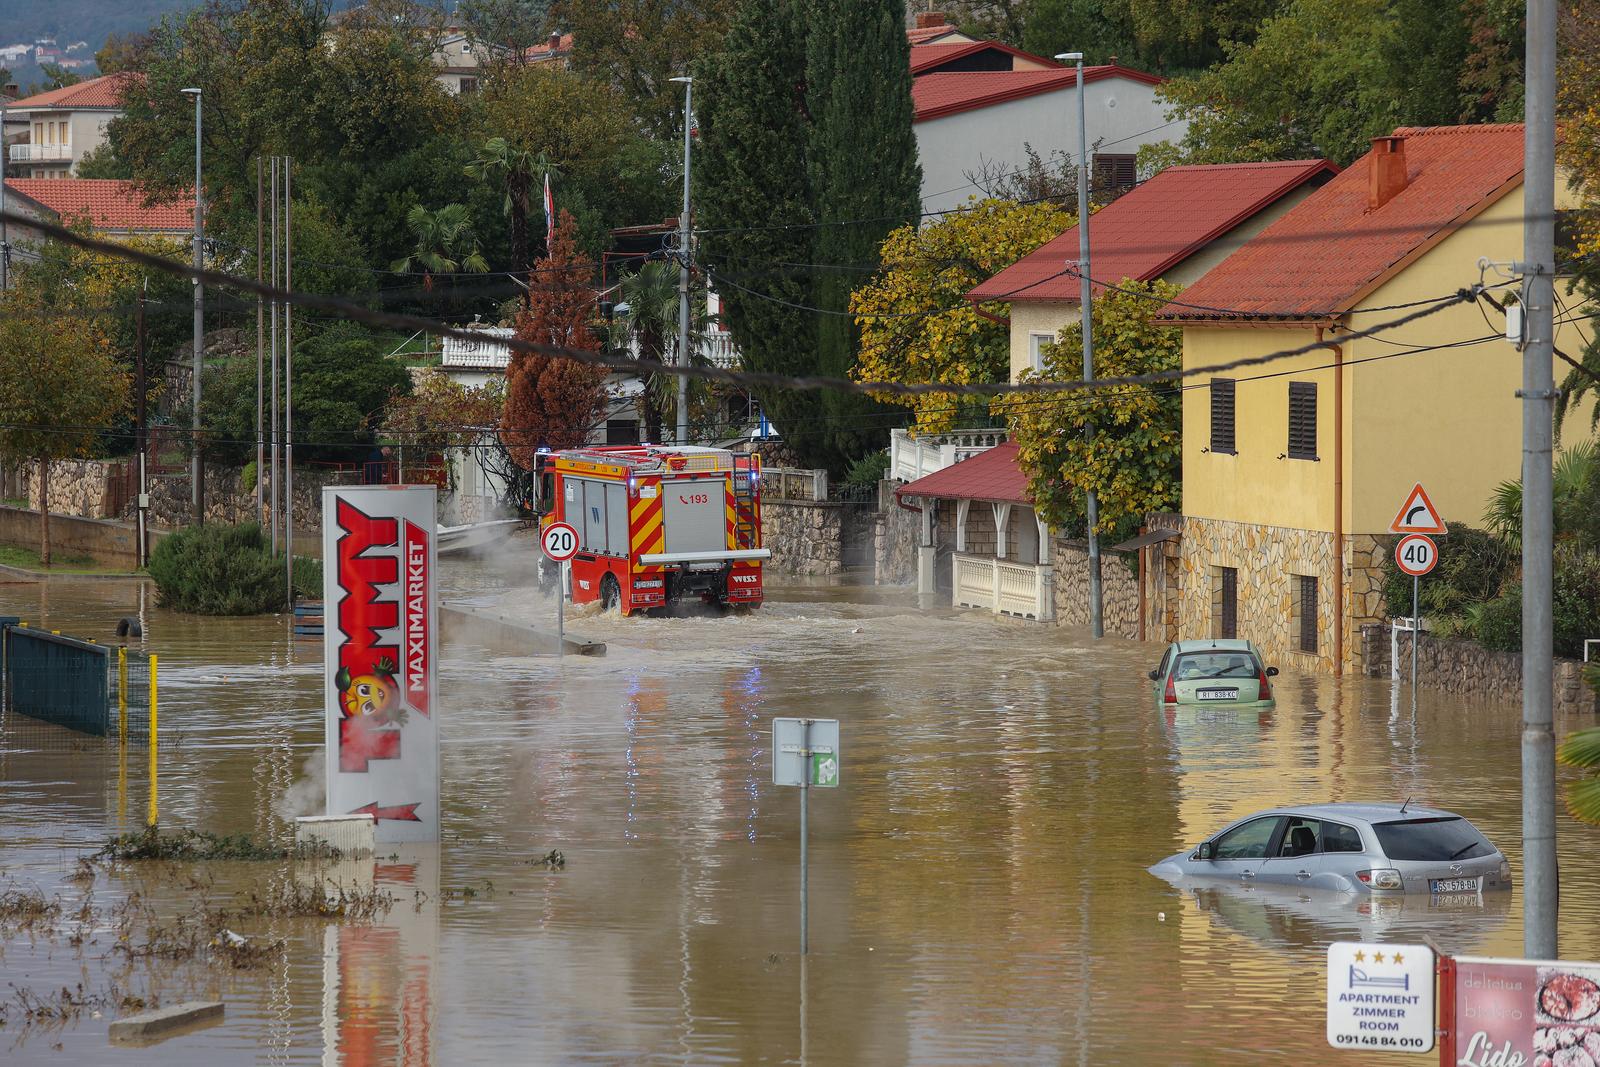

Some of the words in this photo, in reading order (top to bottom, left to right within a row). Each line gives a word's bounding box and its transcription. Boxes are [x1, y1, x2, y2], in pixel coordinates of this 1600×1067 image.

[689, 494, 708, 504] 193
[550, 532, 572, 551] 20
[1404, 544, 1427, 564] 40
[732, 575, 757, 583] WISS
[409, 540, 424, 692] MAXIMARKET
[335, 495, 401, 773] TOMMY
[1438, 881, 1447, 892] GS
[1339, 993, 1420, 1005] APARTMENT
[1352, 1007, 1405, 1018] ZIMMER
[1359, 1021, 1399, 1031] ROOM
[1336, 1034, 1358, 1044] 091
[1361, 1036, 1378, 1045] 48
[1381, 1037, 1397, 1046] 84
[1400, 1038, 1423, 1047] 010
[1457, 1031, 1528, 1067] Lido
